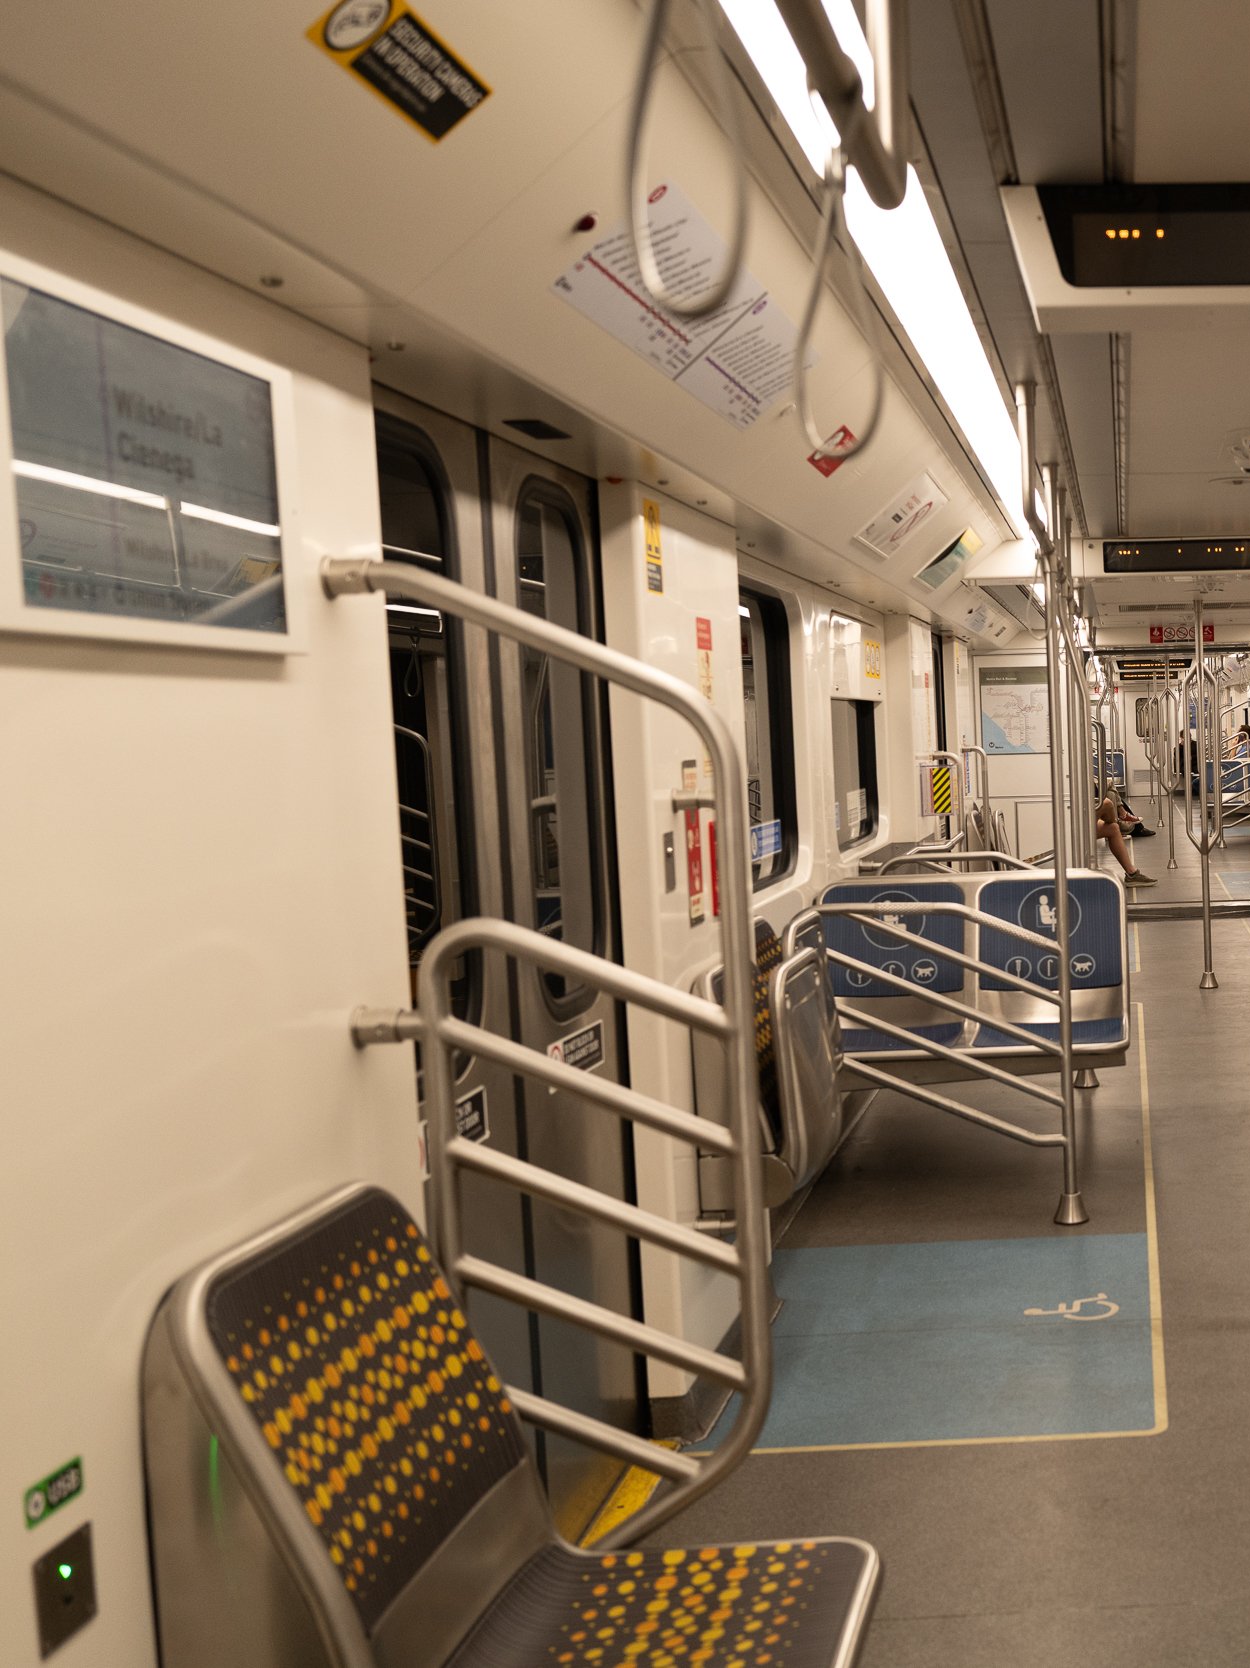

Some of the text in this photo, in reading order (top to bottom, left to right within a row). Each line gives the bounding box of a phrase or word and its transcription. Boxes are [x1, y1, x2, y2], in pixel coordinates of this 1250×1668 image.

[384, 44, 446, 103] OPERATION
[388, 18, 443, 71] SECURITY
[433, 61, 483, 108] CAMERAS
[117, 430, 195, 482] Cienega
